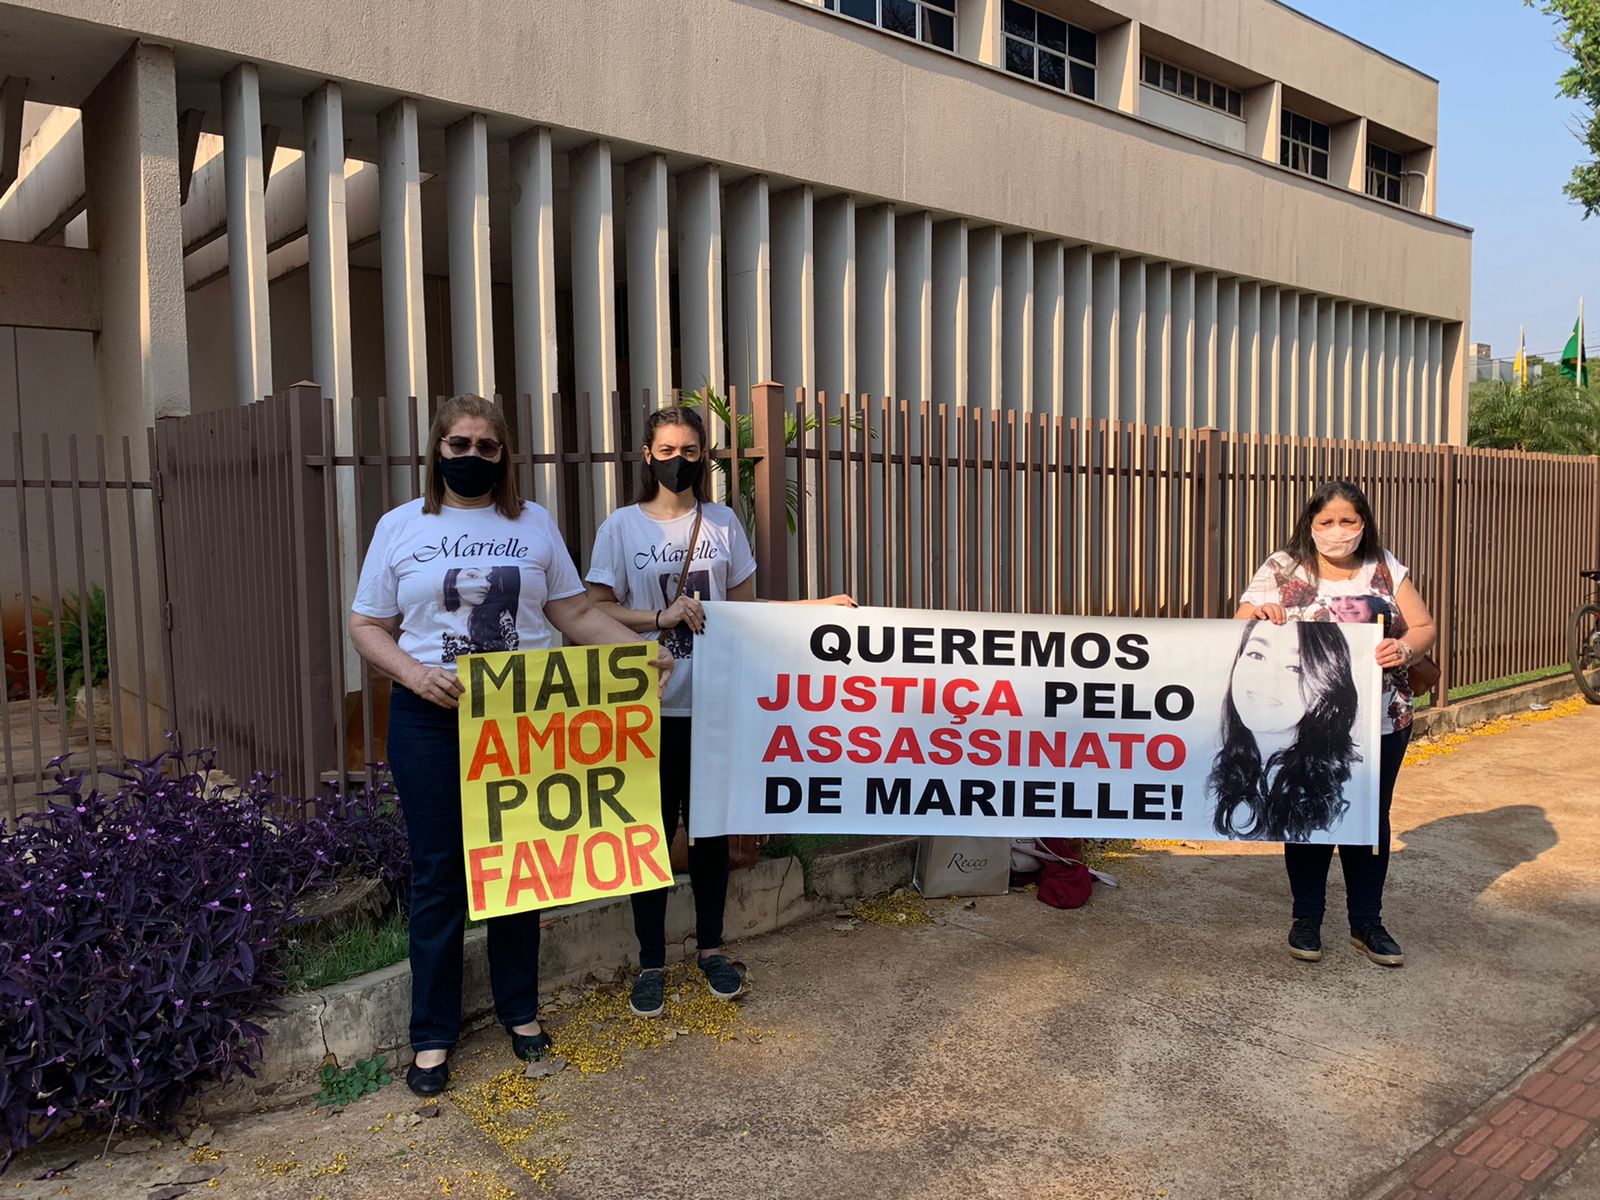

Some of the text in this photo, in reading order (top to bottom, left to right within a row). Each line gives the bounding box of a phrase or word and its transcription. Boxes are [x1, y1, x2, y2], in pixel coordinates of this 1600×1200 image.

[412, 533, 529, 563] Marielle
[633, 539, 718, 570] Marelle
[810, 624, 1150, 671] QUEREMOS
[470, 645, 650, 719] MAIS
[757, 673, 1194, 726] JUSTIÇA PELO
[466, 704, 657, 783] AMOR
[763, 725, 1187, 771] ASSASSINATO
[486, 766, 637, 843] POR
[764, 776, 1184, 821] DE MARIELLE!
[468, 823, 671, 912] FAVOR
[947, 852, 988, 873] Recco
